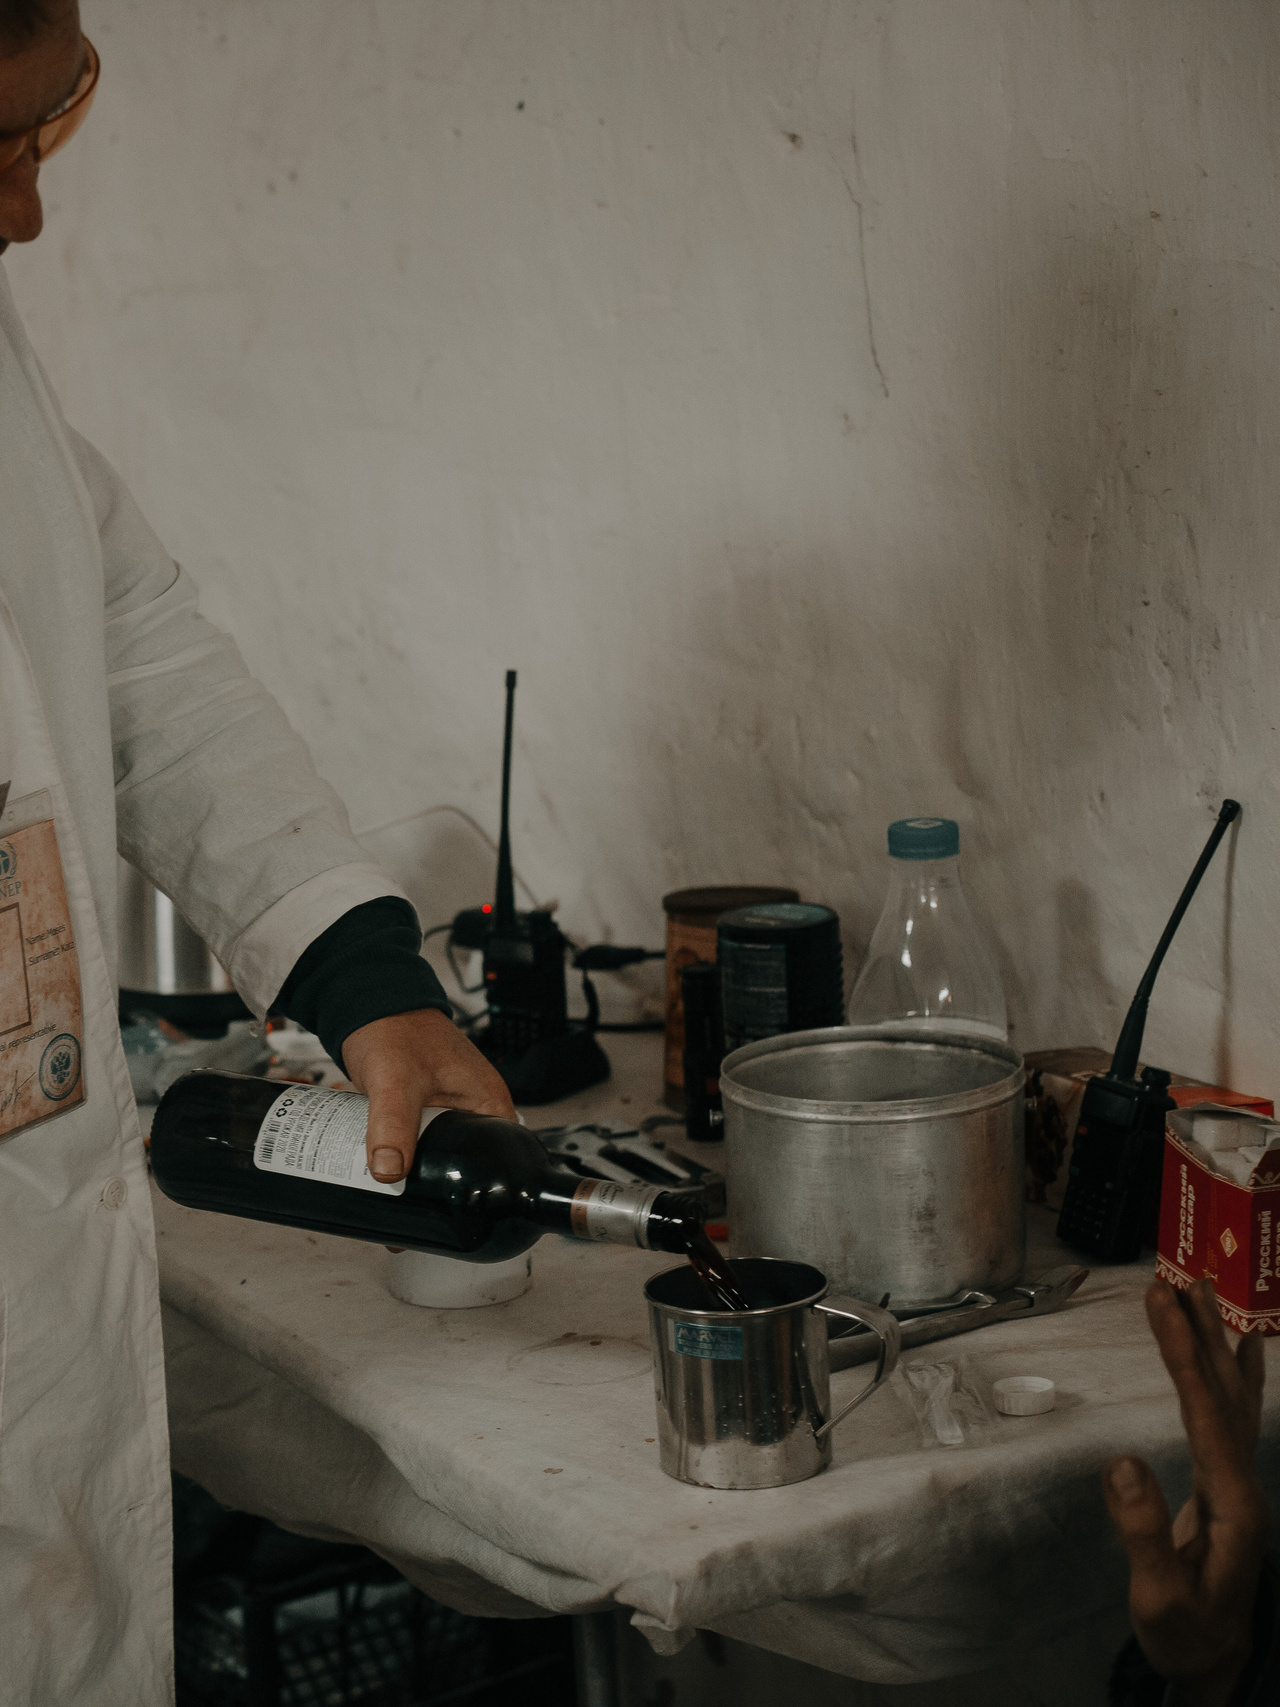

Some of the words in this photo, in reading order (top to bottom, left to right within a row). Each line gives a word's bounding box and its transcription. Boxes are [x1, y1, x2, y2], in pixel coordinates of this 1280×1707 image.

[1177, 1164, 1187, 1266] Русский
[1186, 1185, 1195, 1256] сахар
[1256, 1210, 1272, 1292] Русский
